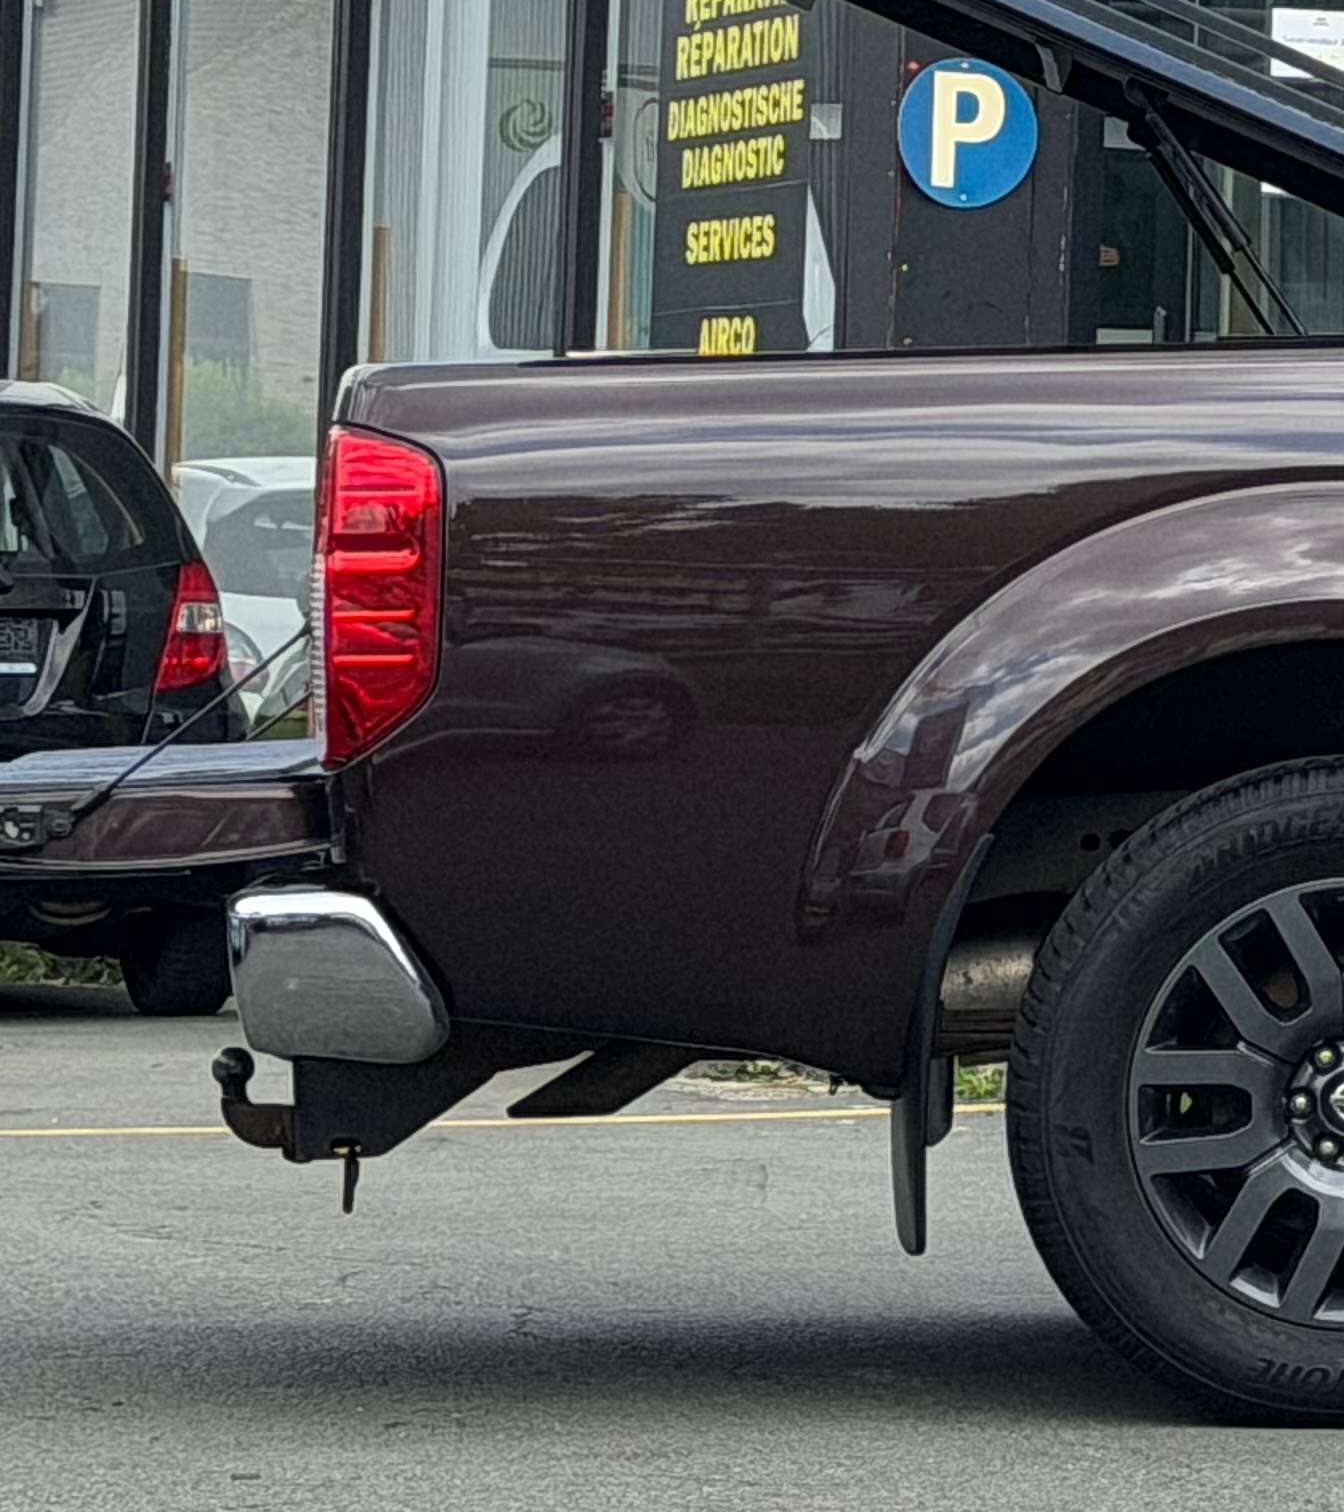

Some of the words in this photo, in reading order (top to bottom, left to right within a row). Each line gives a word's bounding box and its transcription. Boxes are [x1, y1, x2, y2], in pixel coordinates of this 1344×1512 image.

[675, 14, 800, 81] RÉPARATION
[667, 79, 805, 141] DIAGNOSTISCHE
[930, 70, 1005, 189] P
[681, 134, 785, 189] DIAGNOSTIC
[685, 214, 775, 265] SERVICES
[698, 315, 756, 355] AIRCO
